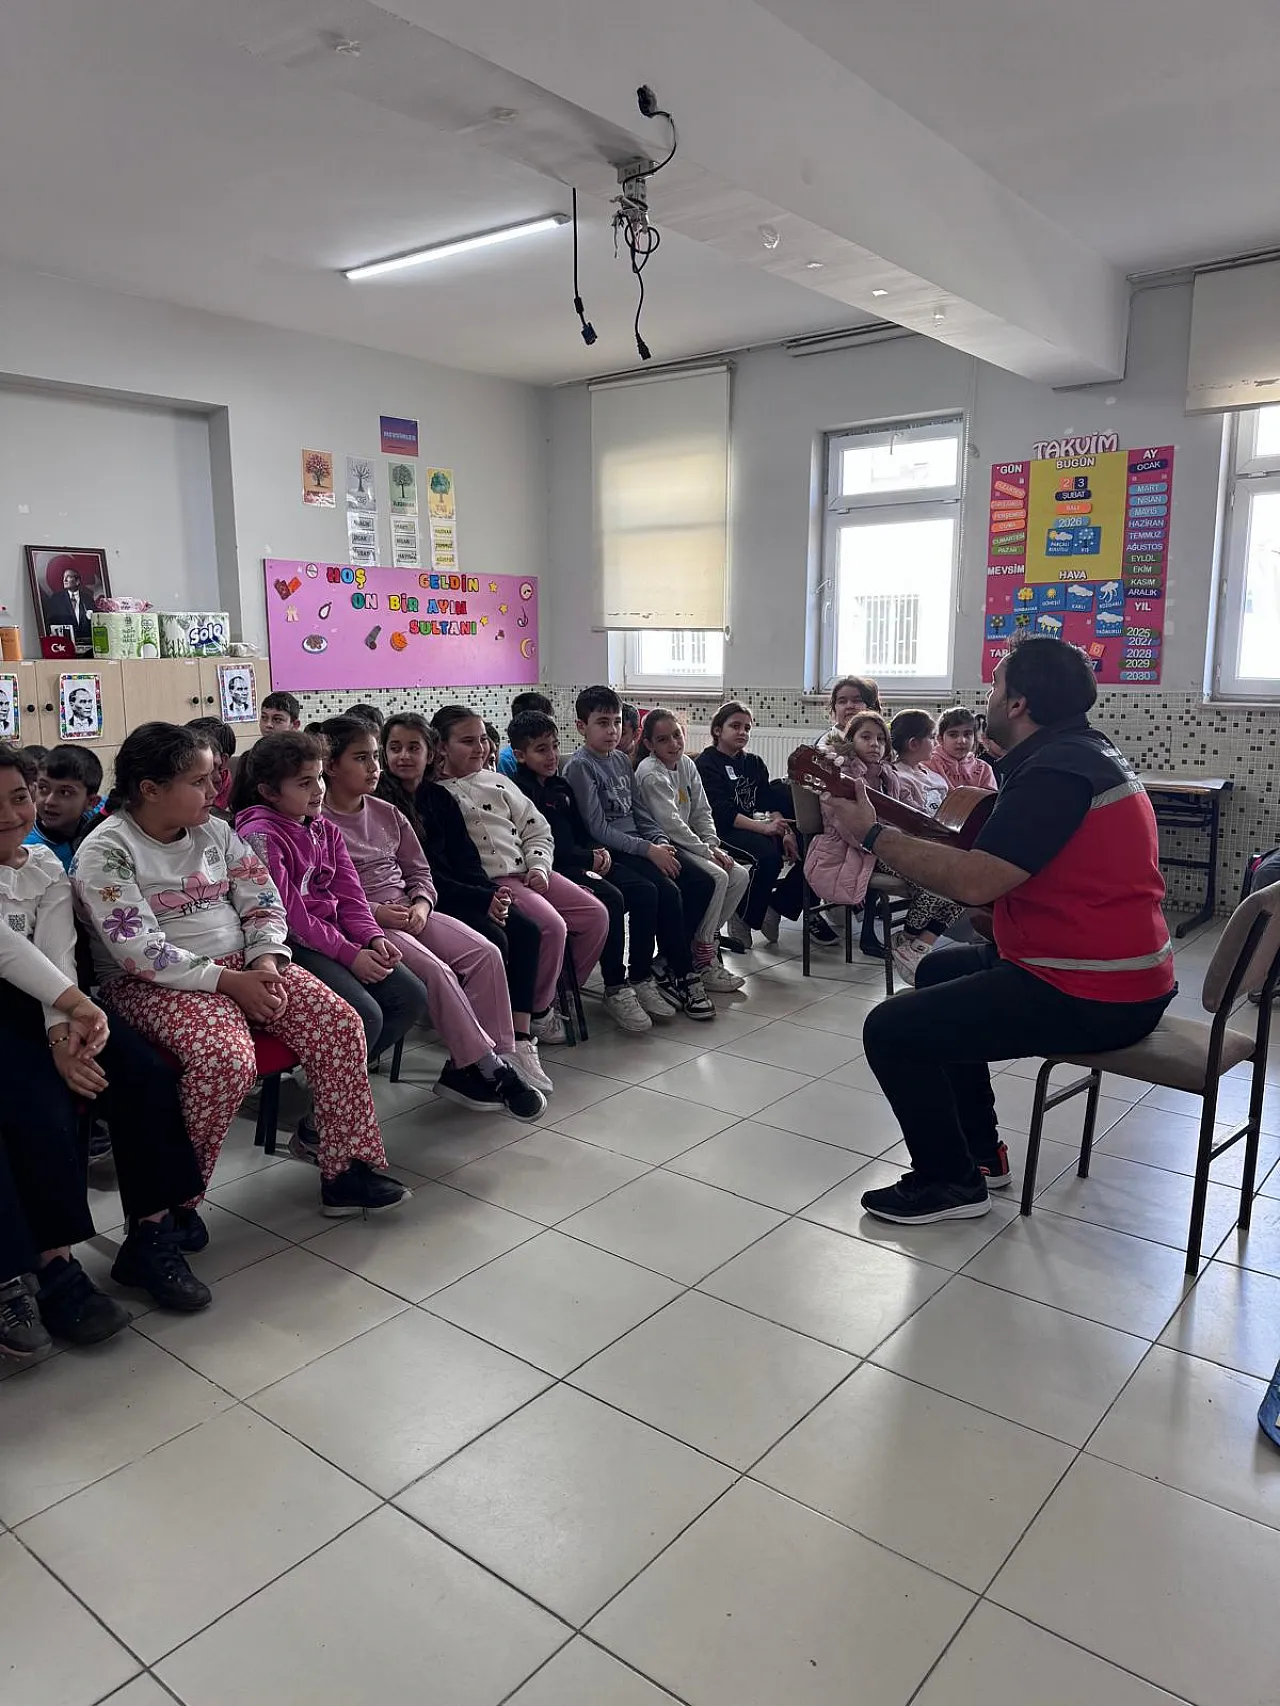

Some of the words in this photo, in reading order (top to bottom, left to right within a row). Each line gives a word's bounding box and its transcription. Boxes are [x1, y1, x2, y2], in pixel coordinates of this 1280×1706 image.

[1032, 433, 1118, 460] TAKVİM
[1143, 449, 1158, 460] AY
[1056, 457, 1095, 469] BUGÜN
[1136, 461, 1161, 471] OCAK
[1000, 464, 1022, 474] GÜN
[1137, 485, 1159, 493] MART
[1058, 518, 1082, 527] 2026
[1128, 518, 1164, 528] HAZİRAN
[1130, 531, 1161, 540] TEMMUZ
[1126, 542, 1163, 551] AĞUSTOS
[1131, 553, 1155, 562] EYLÜL
[987, 564, 1025, 575] MEVSİM
[1133, 565, 1152, 573] EKİM
[1059, 570, 1087, 580] HAVA
[326, 567, 367, 590] HOŞ
[418, 573, 480, 593] GELDİN
[1128, 588, 1157, 596] ARALIK
[351, 592, 378, 610] ON
[388, 592, 419, 613] BİR
[426, 598, 468, 615] AYIN
[1135, 602, 1151, 611] YIL
[409, 619, 477, 635] SULTANI
[1127, 627, 1151, 637] 2025
[1129, 637, 1152, 646] 2027
[1127, 649, 1151, 658] 2028
[1126, 659, 1150, 668] 2029
[1127, 671, 1151, 680] 2030
